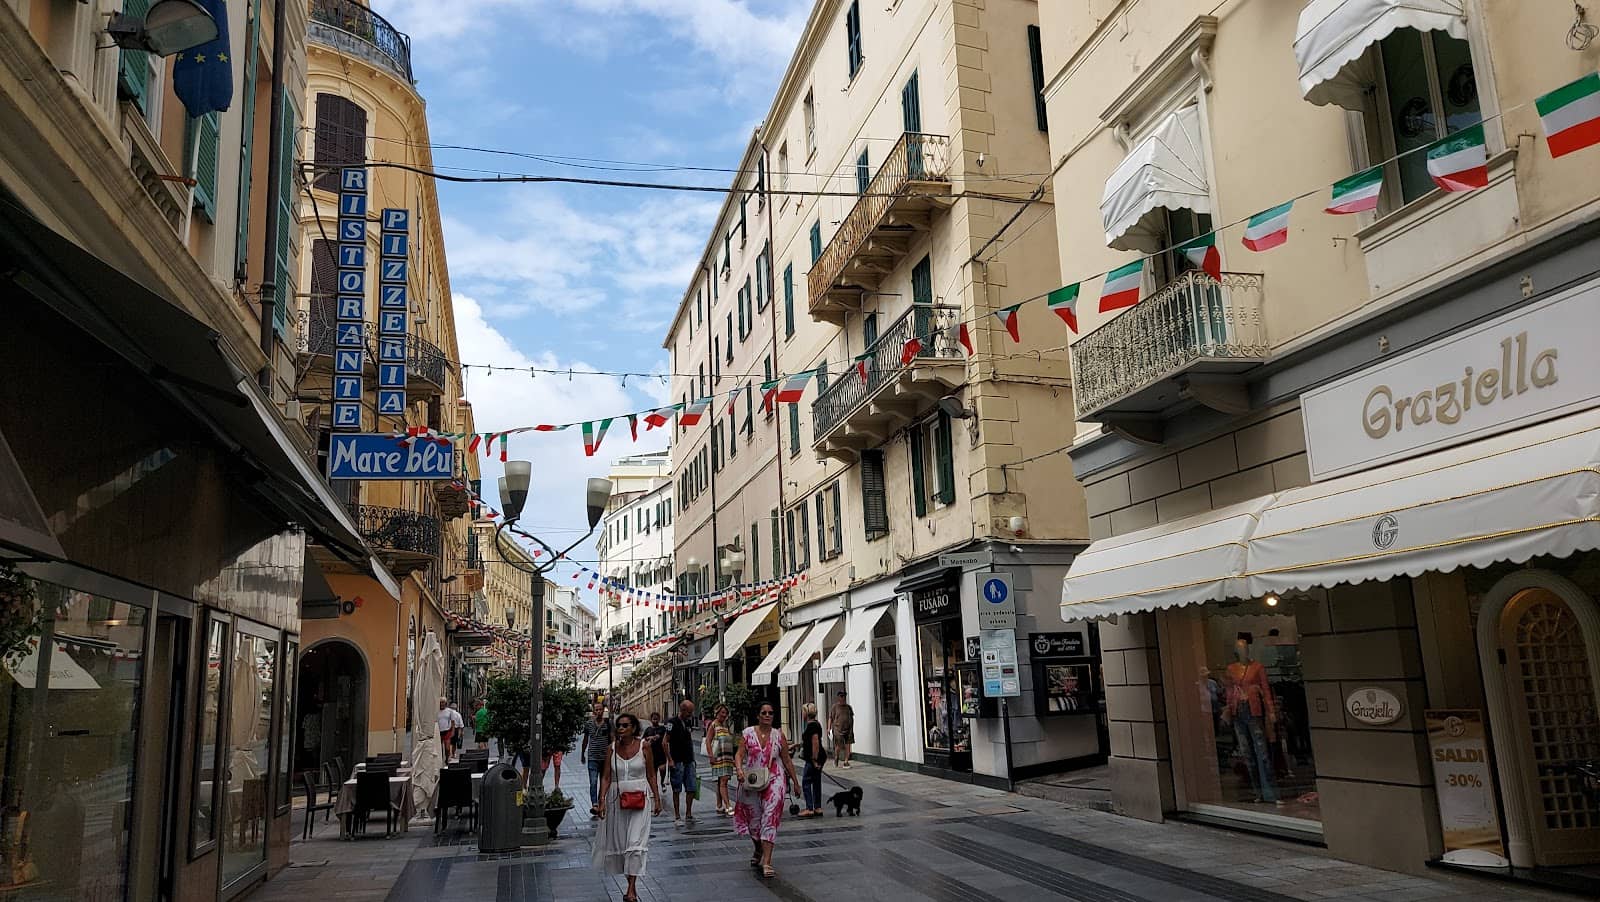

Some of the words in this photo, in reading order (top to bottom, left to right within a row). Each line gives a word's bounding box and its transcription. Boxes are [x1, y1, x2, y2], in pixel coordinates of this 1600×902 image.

[338, 170, 365, 426] RISTORANTE
[382, 211, 407, 412] PIZZERIA
[1362, 331, 1559, 439] Graziella
[332, 438, 400, 474] Mare
[404, 437, 451, 475] blu
[919, 594, 949, 612] FUSARO
[1434, 748, 1485, 763] SALDI
[1445, 774, 1482, 788] -30%
